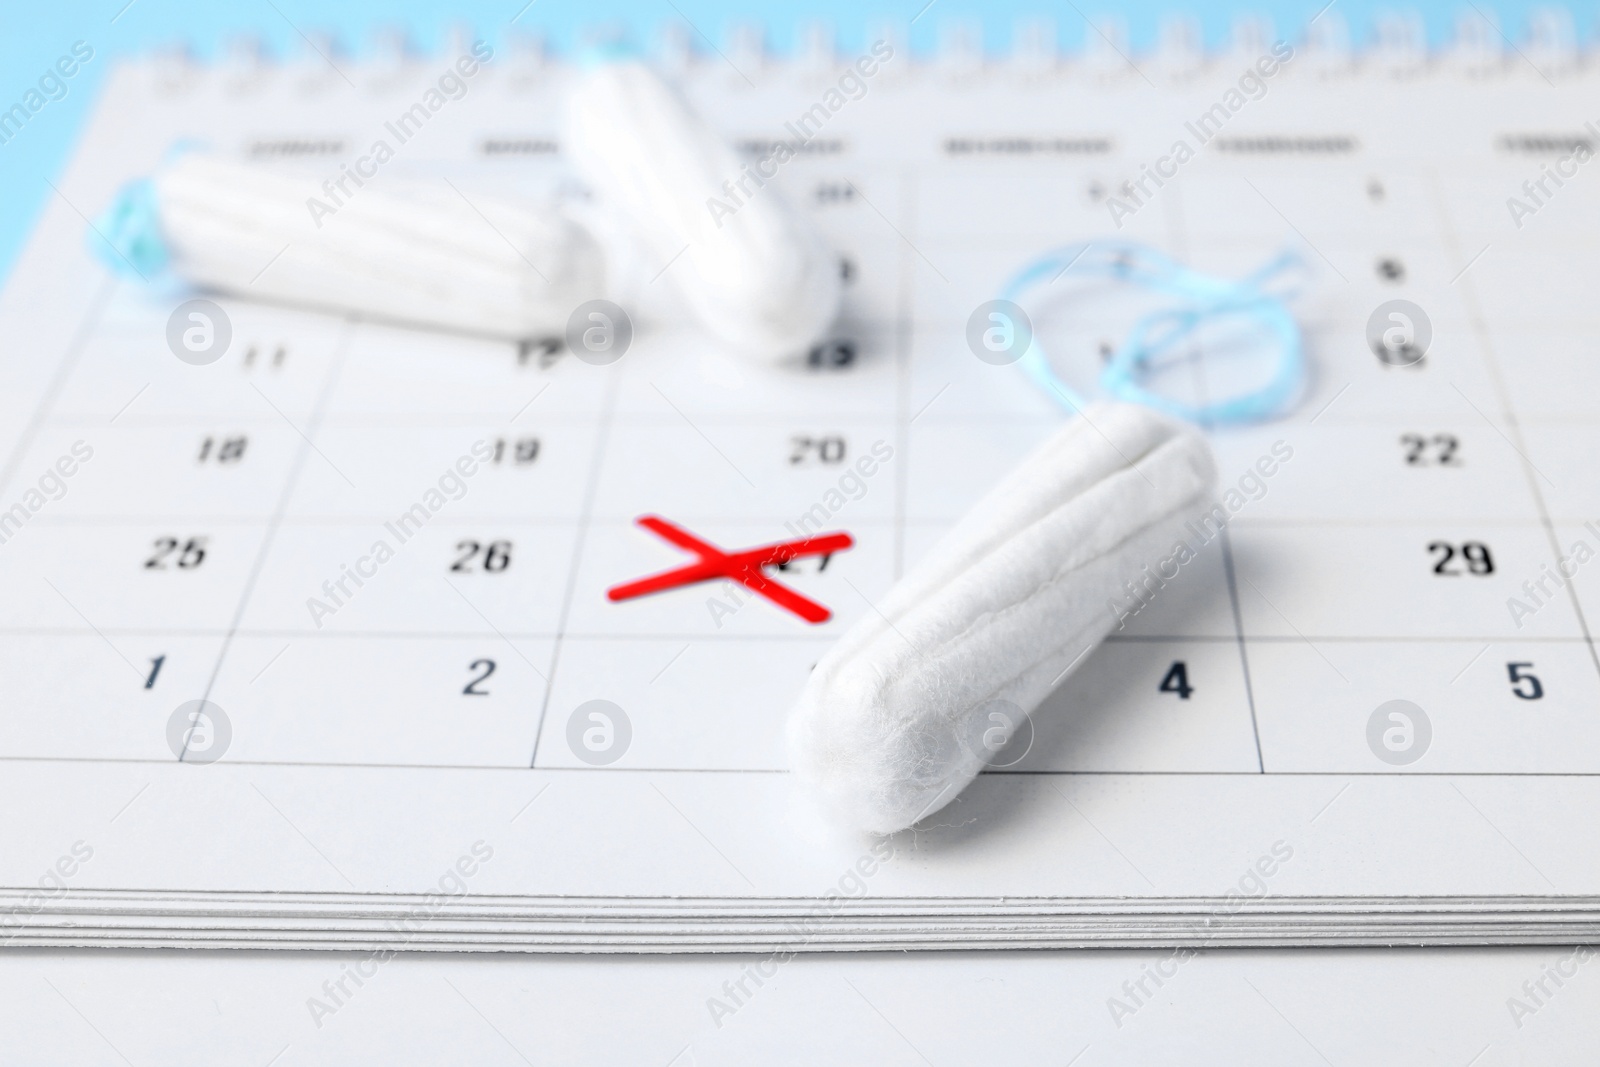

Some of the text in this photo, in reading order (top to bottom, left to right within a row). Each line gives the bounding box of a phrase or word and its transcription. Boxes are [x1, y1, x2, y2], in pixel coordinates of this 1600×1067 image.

[198, 435, 248, 465] 18
[493, 437, 541, 466] 19
[788, 436, 847, 465] 20
[1400, 435, 1462, 466] 22
[143, 536, 208, 570] 25
[449, 538, 513, 574] 26
[1427, 540, 1496, 577] 29
[143, 654, 167, 690] 1
[462, 657, 497, 697] 2
[1157, 660, 1195, 701] 4
[1506, 662, 1545, 702] 5
